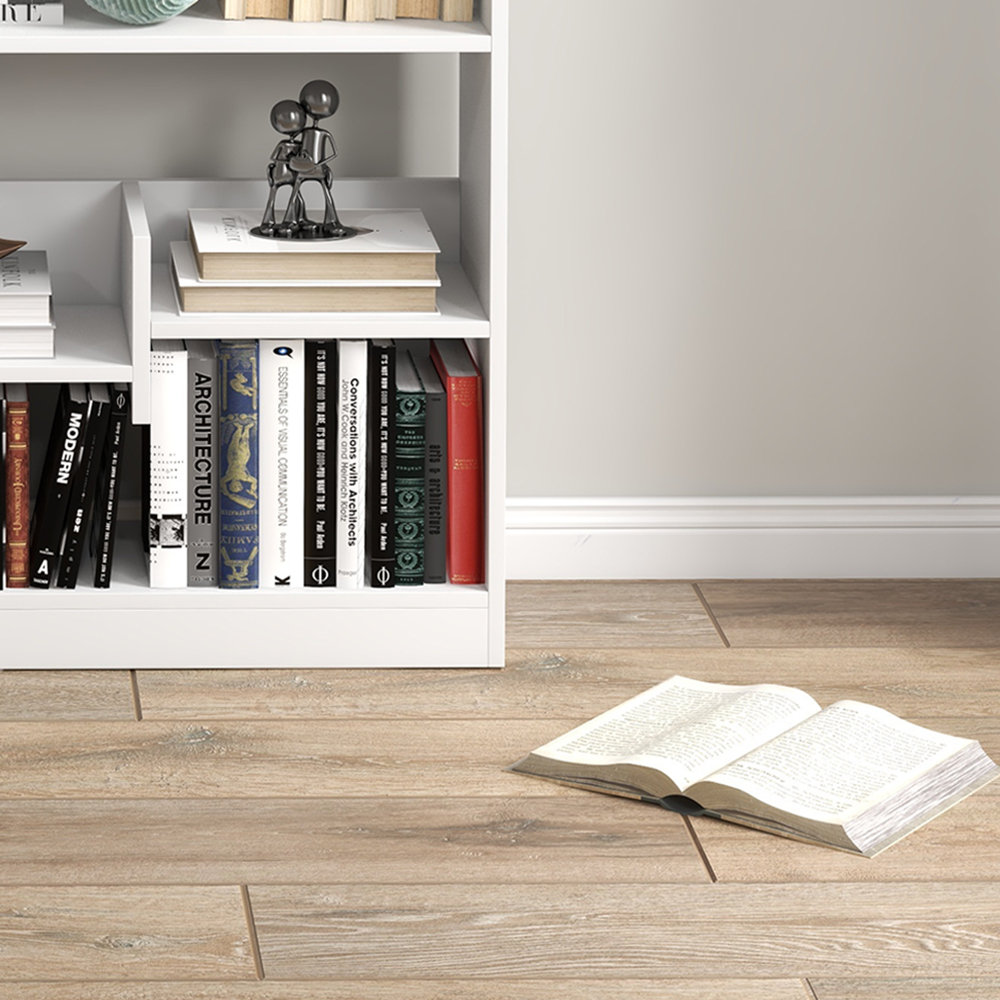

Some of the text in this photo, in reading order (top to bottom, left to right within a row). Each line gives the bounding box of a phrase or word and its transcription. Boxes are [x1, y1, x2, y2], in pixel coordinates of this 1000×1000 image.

[56, 412, 83, 485] MODERN
[195, 372, 212, 525] ARCHITECTURE
[278, 367, 289, 526] ESSENTIALS OF VISUAL COMMUNICATION
[341, 379, 349, 522] John W.Cook and Heinrich Klotz
[348, 378, 360, 547] Conversations with Architects
[429, 444, 442, 463] arts
[73, 508, 84, 533] zen
[316, 520, 326, 549] Paul Arden
[429, 478, 442, 535] architecture
